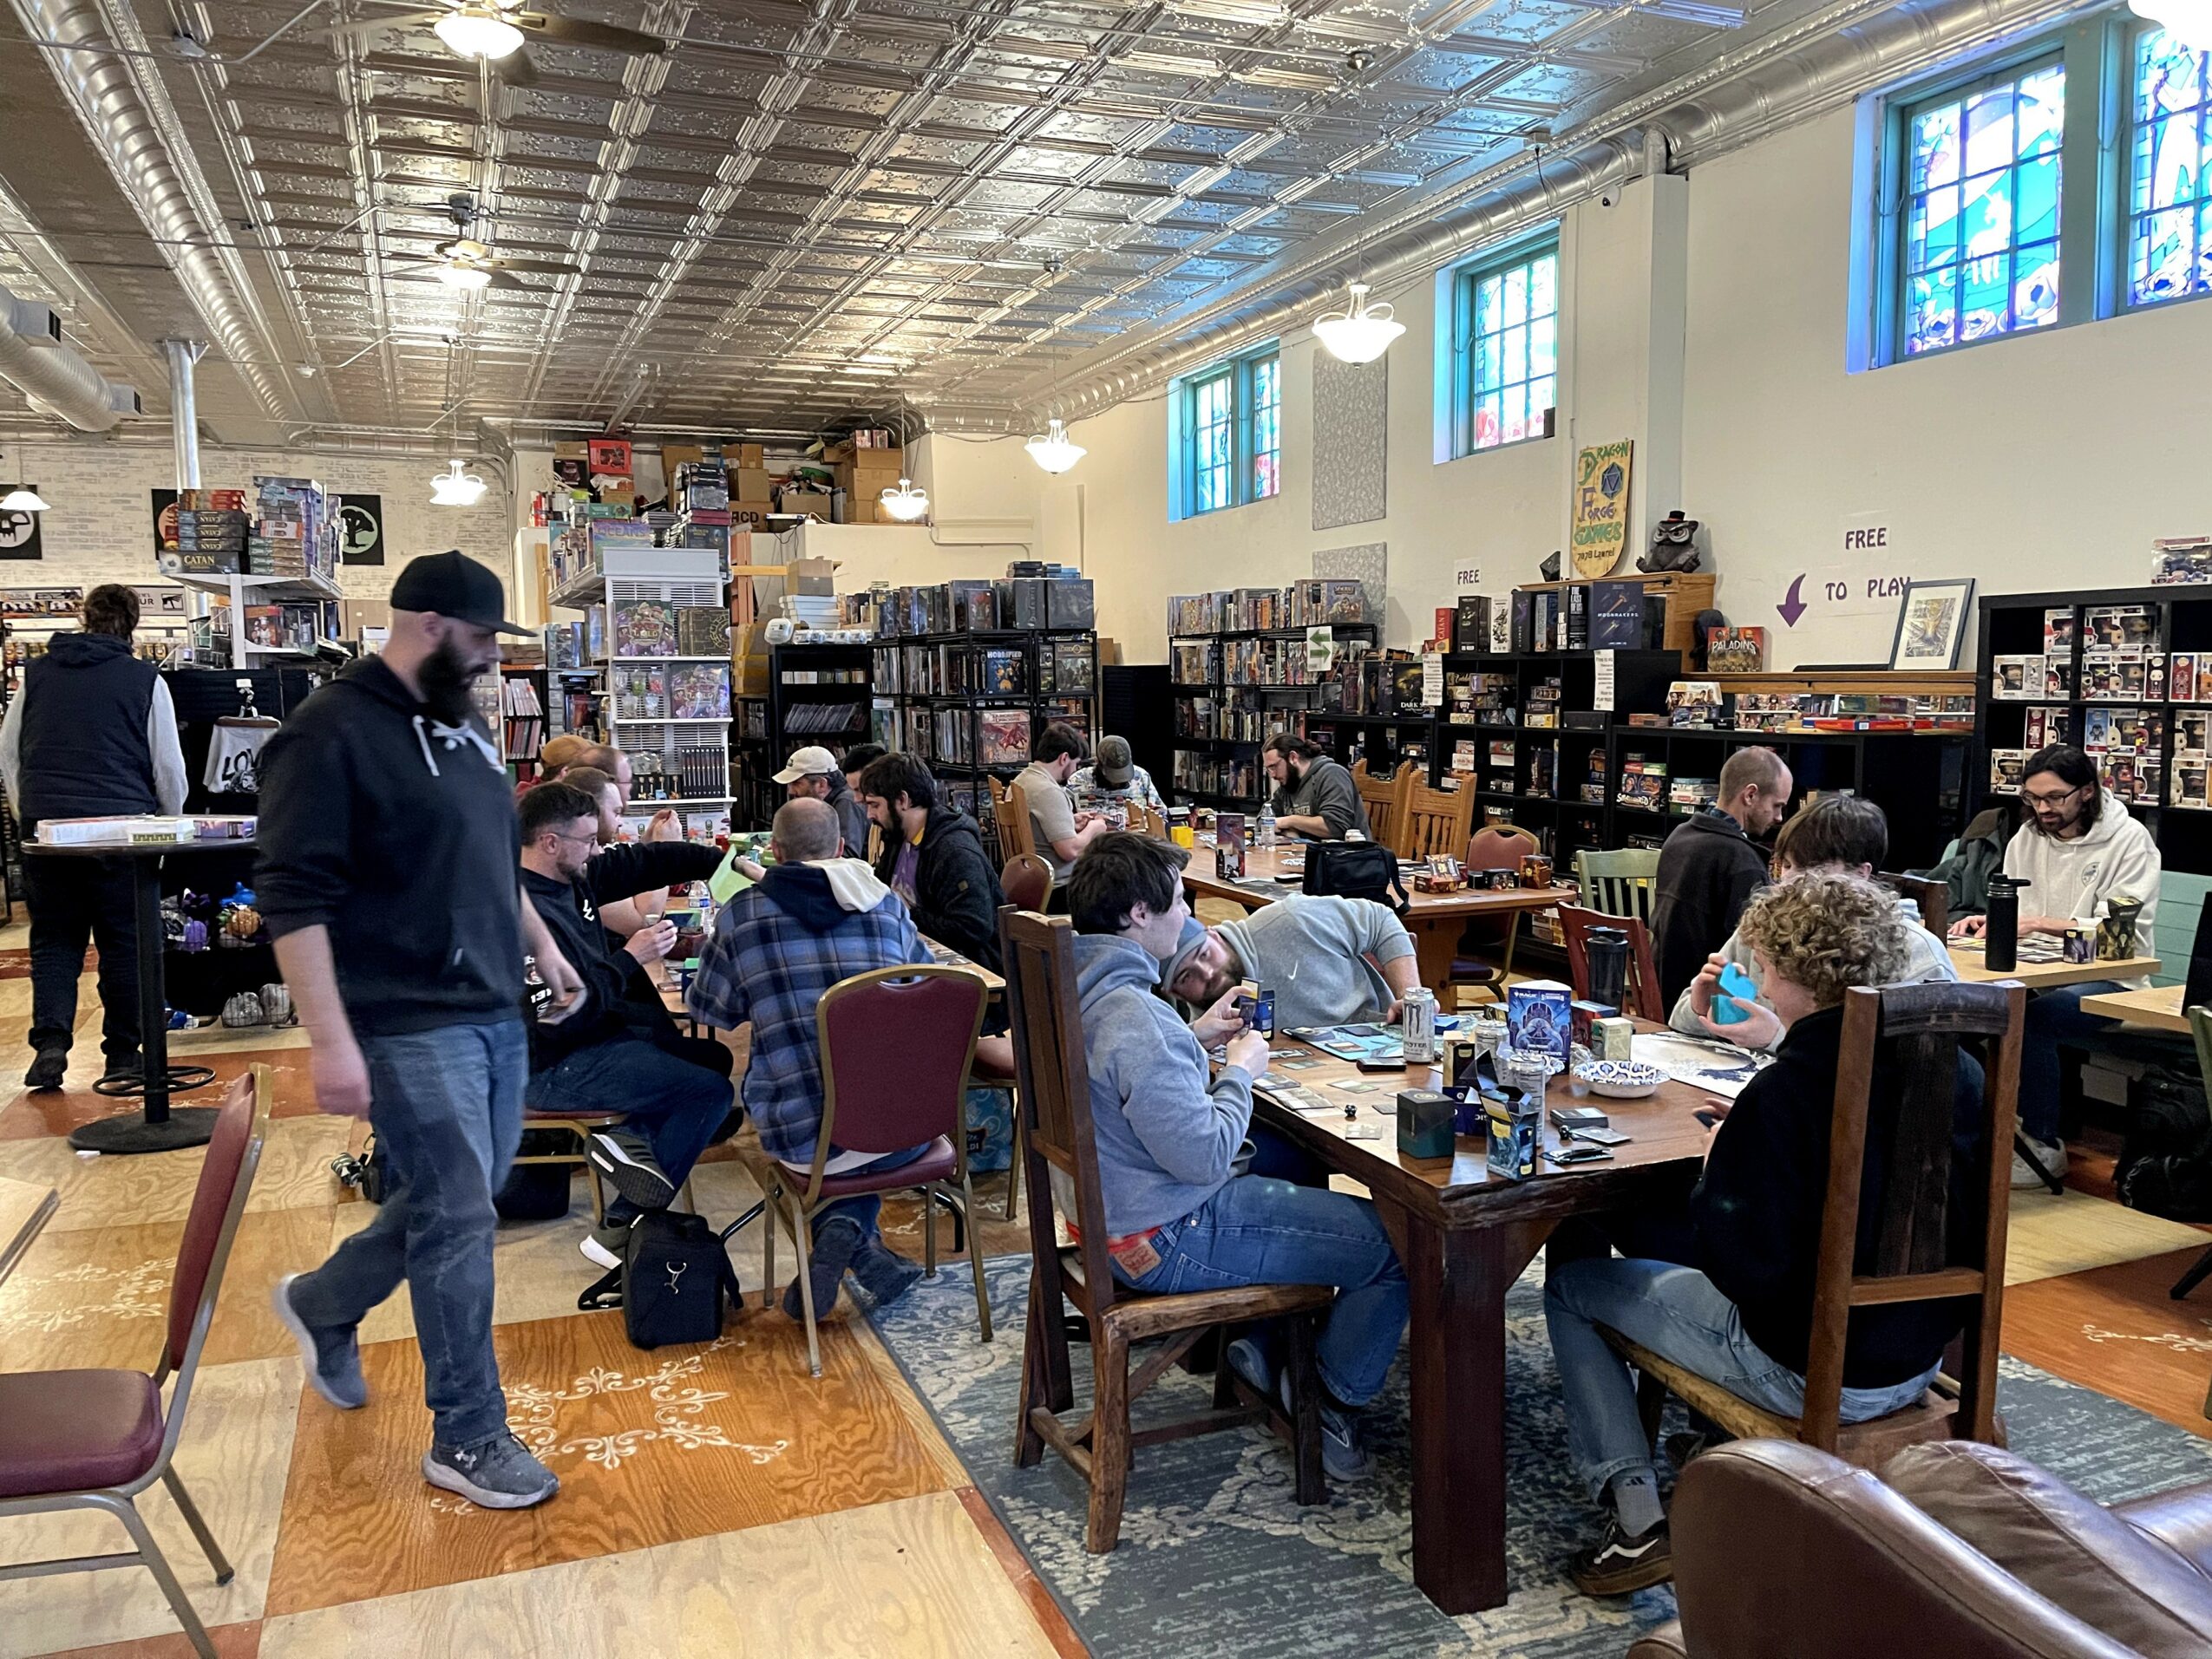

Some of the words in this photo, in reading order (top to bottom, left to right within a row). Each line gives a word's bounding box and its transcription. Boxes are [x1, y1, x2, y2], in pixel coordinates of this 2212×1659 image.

[1574, 521, 1624, 546] GAMES
[1845, 527, 1888, 550] FREE
[183, 554, 215, 565] CATAN
[1457, 569, 1480, 585] FREE
[1825, 582, 1848, 601] TO
[1867, 576, 1911, 598] PLAY
[987, 650, 1023, 659] HORRIFIED
[1711, 640, 1757, 656] PALADINS
